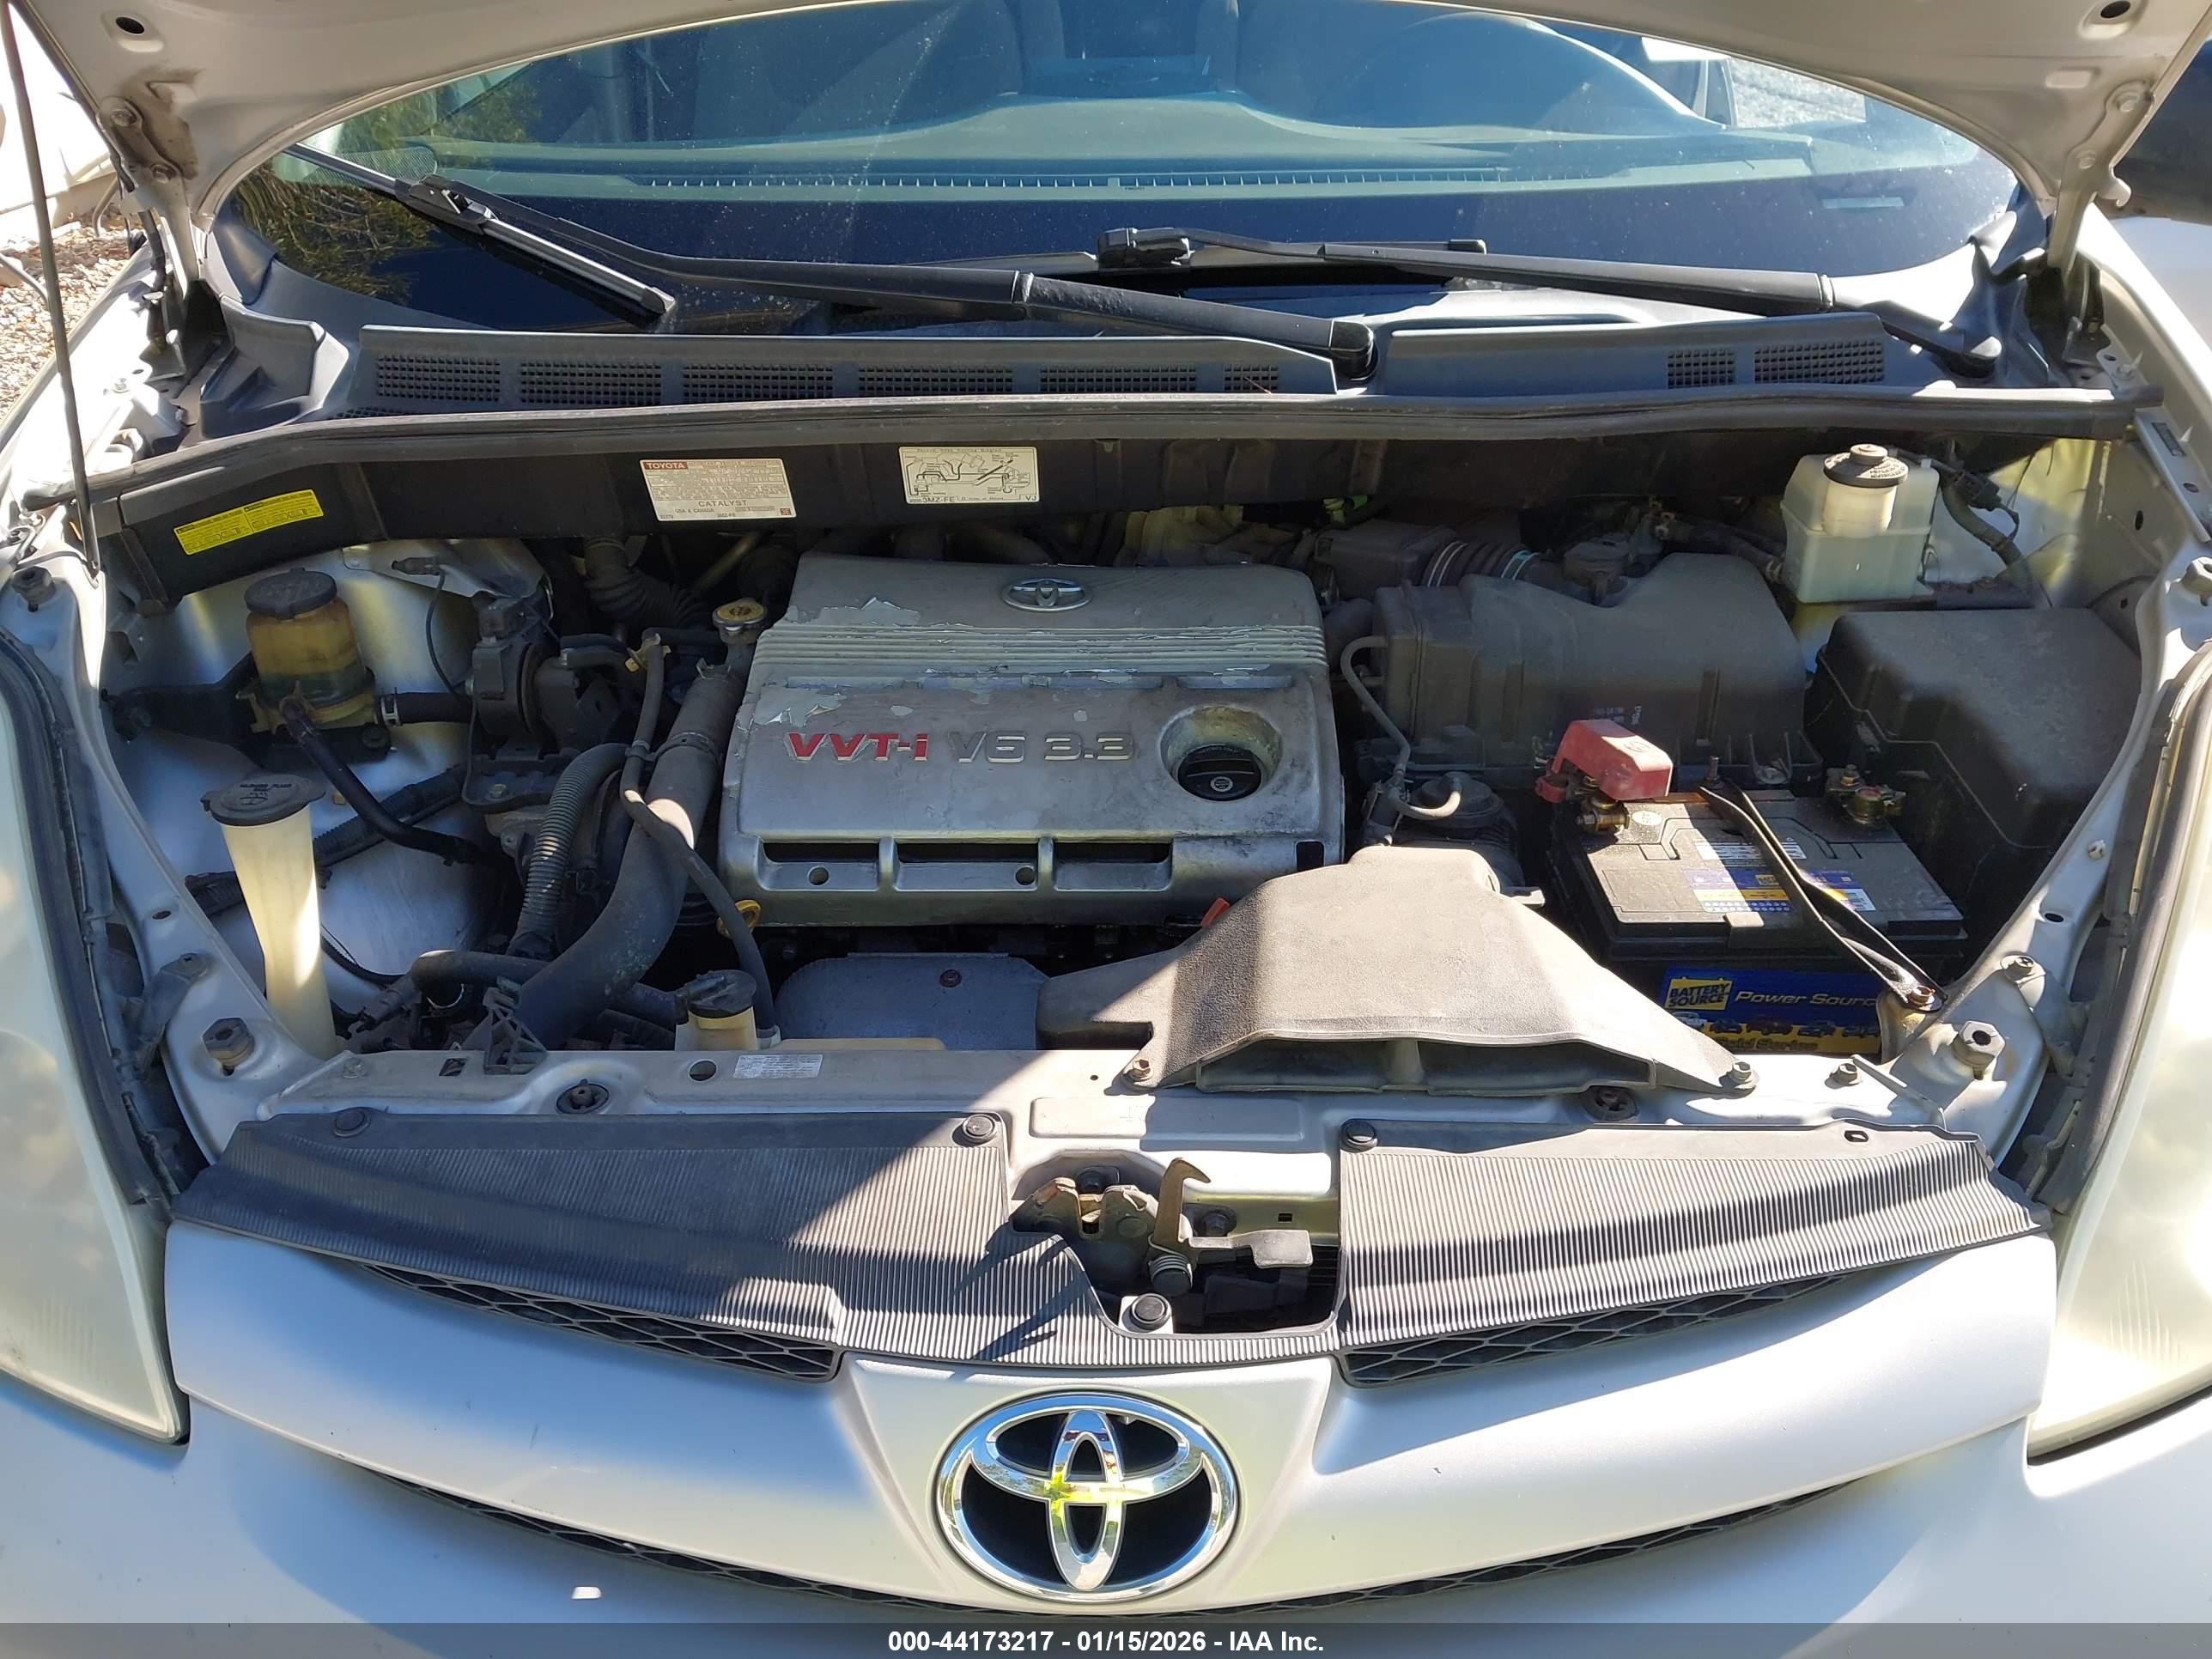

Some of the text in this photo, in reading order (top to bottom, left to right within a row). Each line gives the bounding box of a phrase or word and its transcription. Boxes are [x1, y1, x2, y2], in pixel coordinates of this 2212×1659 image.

[697, 499, 748, 507] CATALYST
[787, 731, 1134, 763] VVT-i V6 3.3
[1669, 981, 1729, 999] BATTERY
[1668, 994, 1725, 1008] SOURCE
[1735, 991, 1878, 1007] Power Sourc
